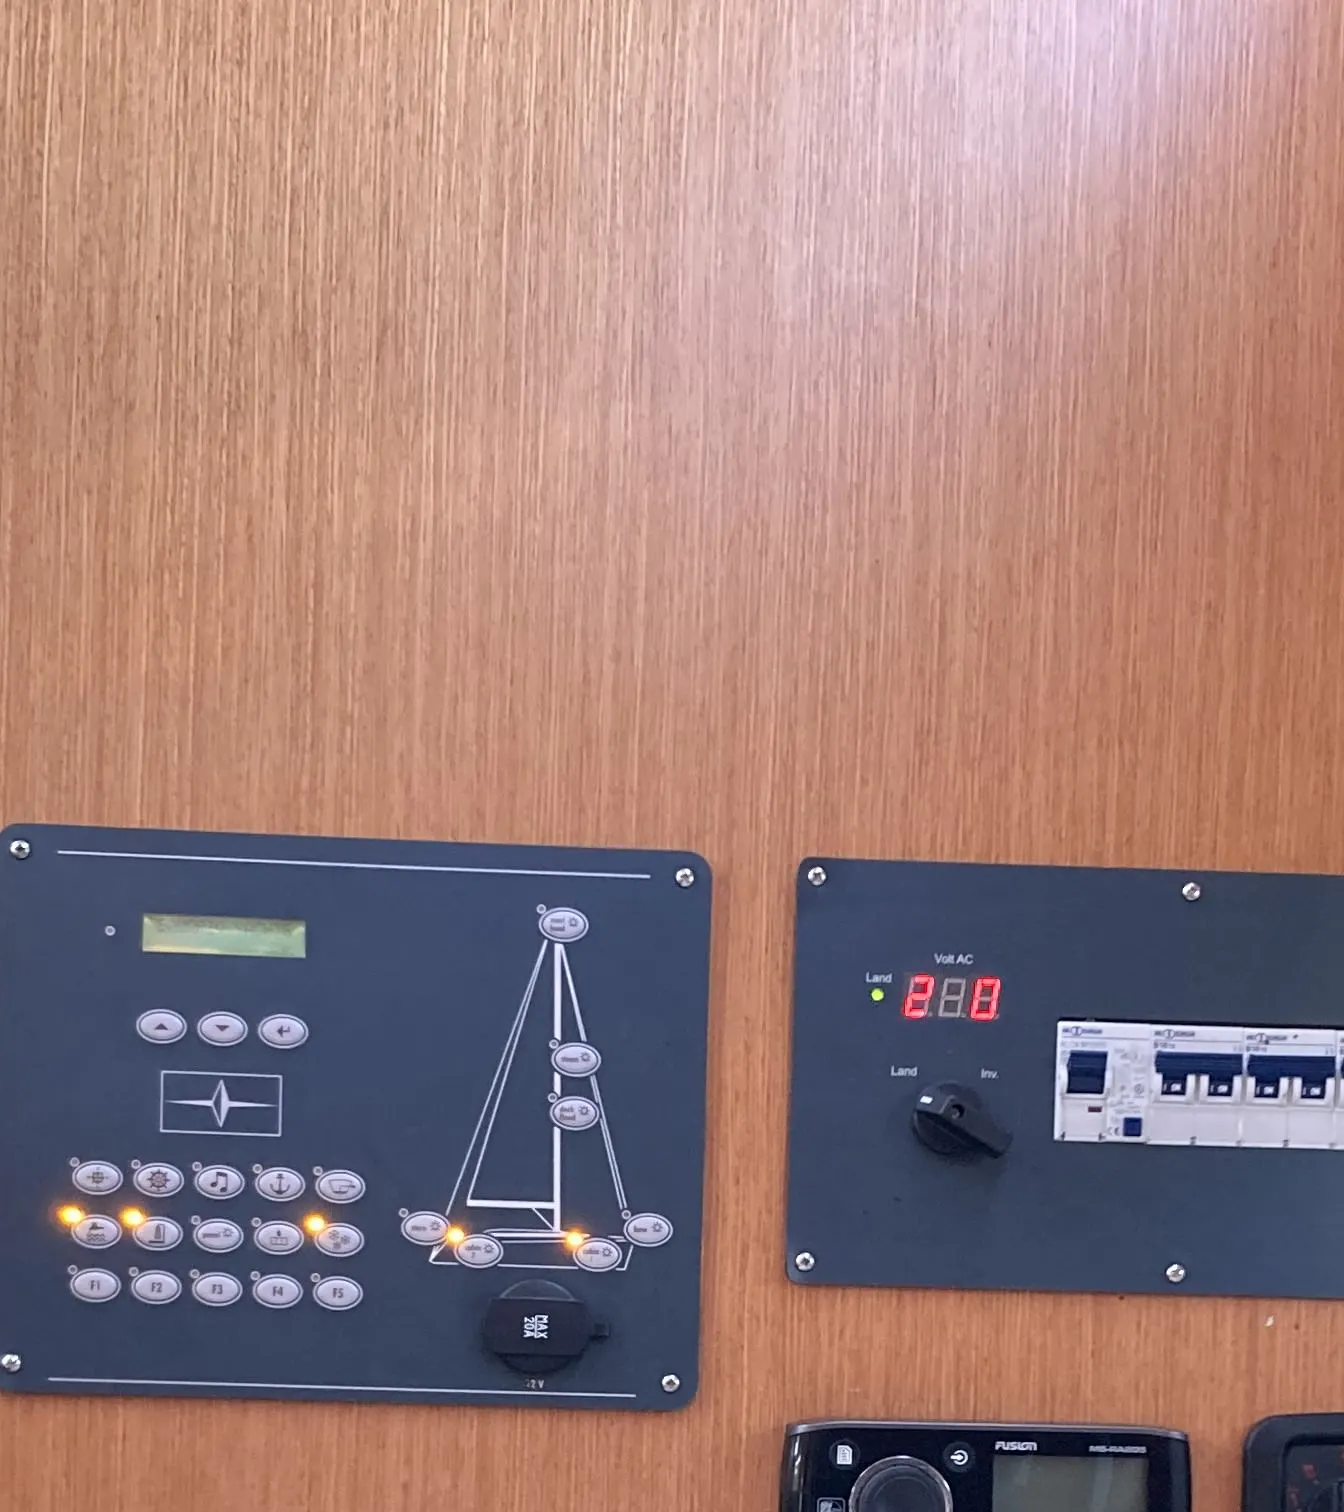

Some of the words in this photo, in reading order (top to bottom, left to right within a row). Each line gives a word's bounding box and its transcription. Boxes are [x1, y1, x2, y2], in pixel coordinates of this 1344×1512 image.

[934, 953, 956, 965] Volt
[956, 954, 974, 965] AC
[865, 972, 893, 984] Land
[890, 1065, 918, 1077] Land
[90, 1279, 101, 1291] F1
[150, 1281, 163, 1293] F2
[211, 1284, 223, 1295] F3
[272, 1286, 284, 1297] F4
[332, 1287, 344, 1298] F5
[522, 1316, 536, 1338] 20A
[535, 1314, 549, 1339] MAX
